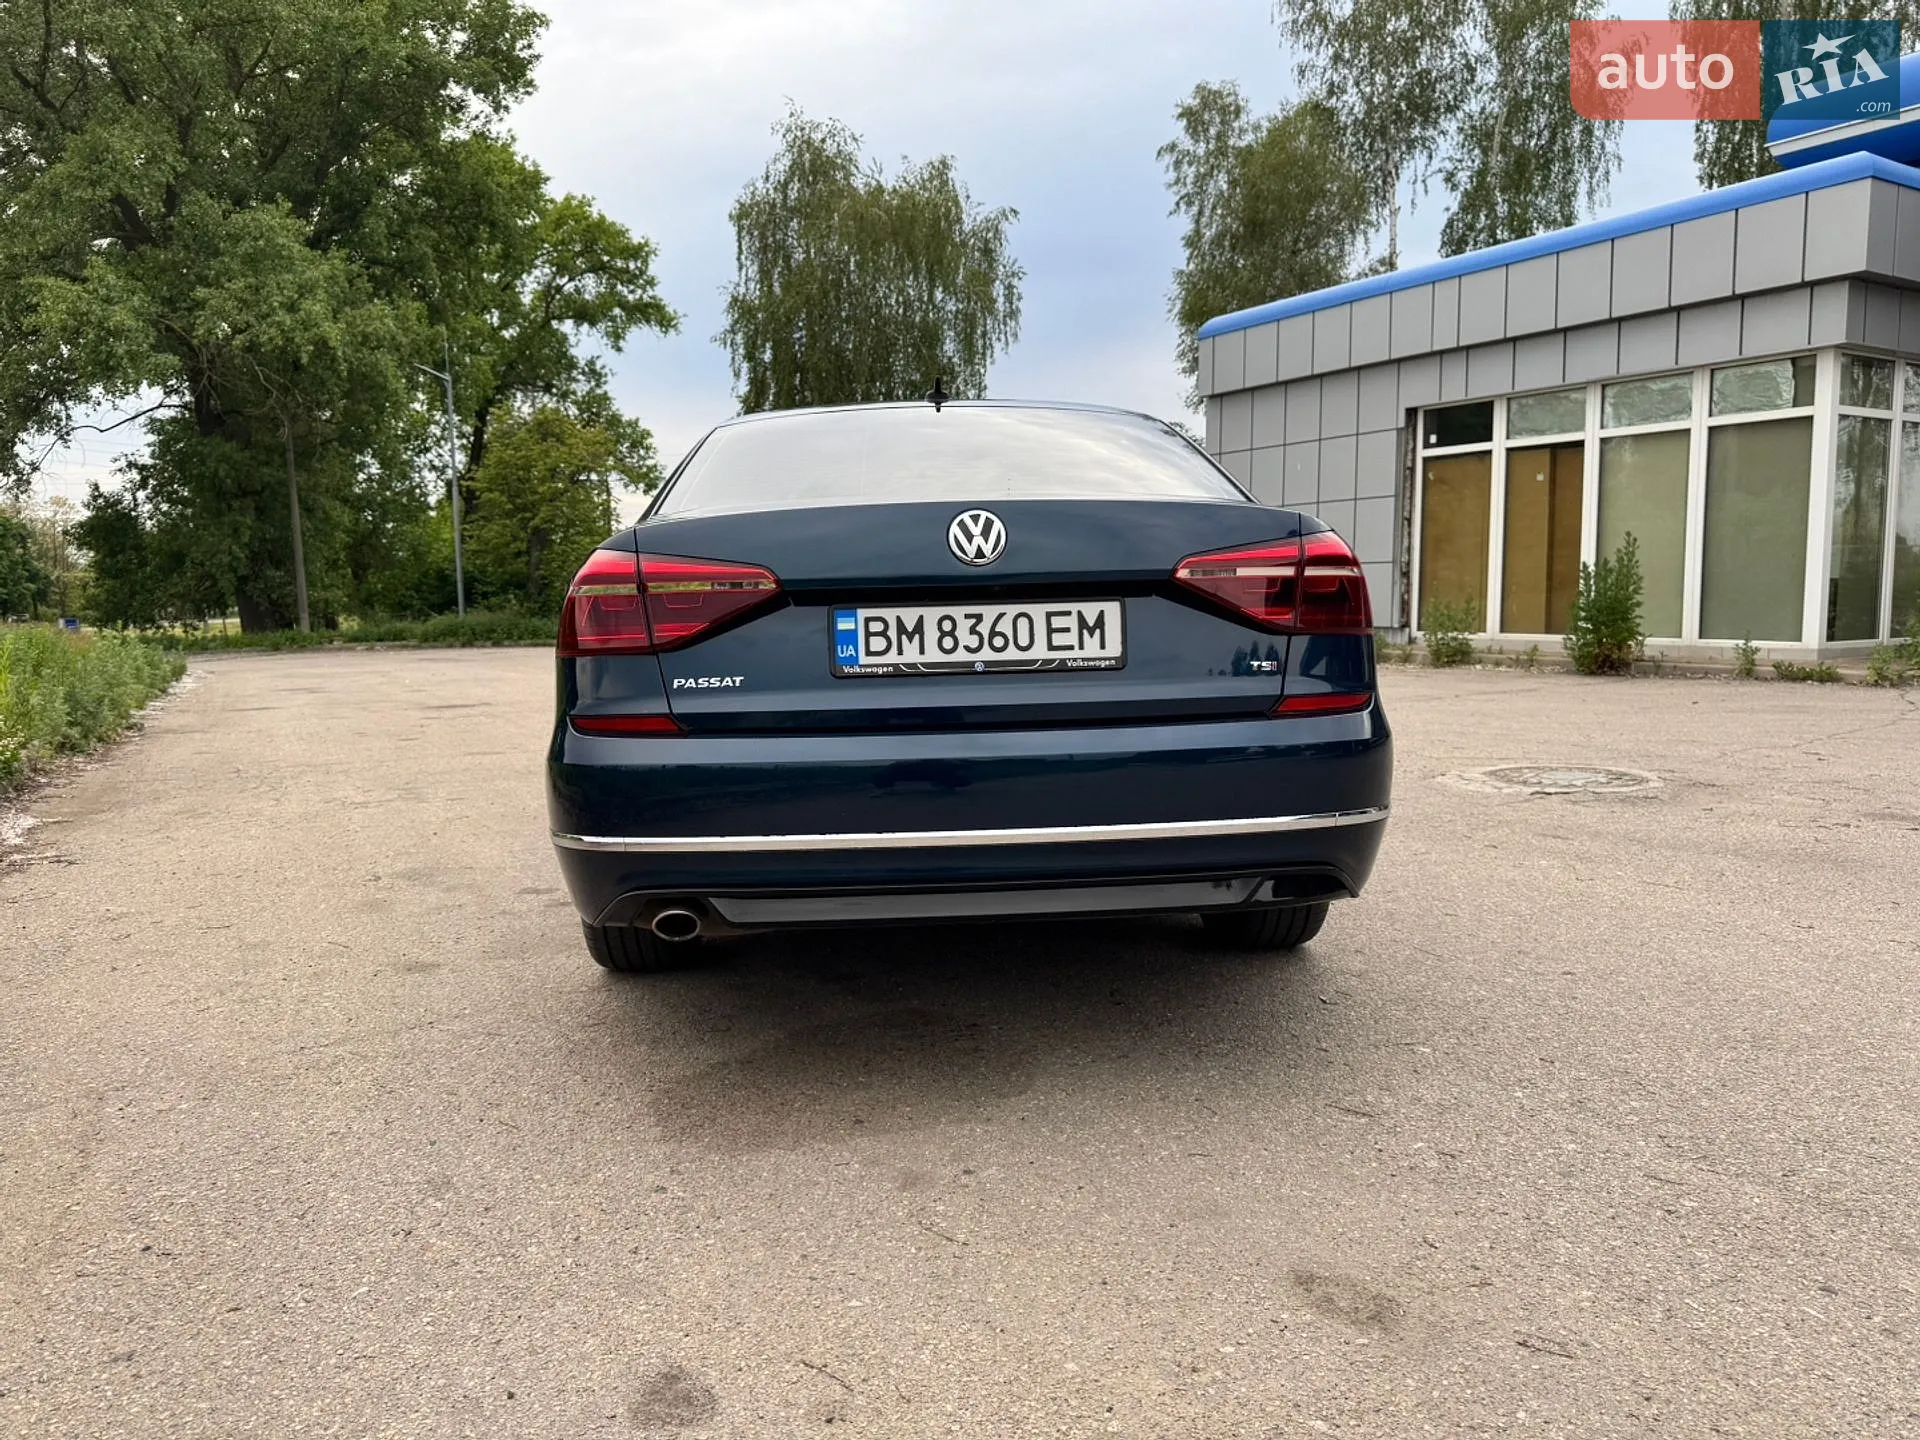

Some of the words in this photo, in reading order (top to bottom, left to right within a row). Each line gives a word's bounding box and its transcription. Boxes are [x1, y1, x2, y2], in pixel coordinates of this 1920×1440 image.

[863, 614, 925, 657] BM
[937, 611, 1035, 655] 8360
[1045, 609, 1106, 652] EM
[837, 645, 857, 658] UA
[1066, 658, 1116, 668] Volkswagen
[1250, 661, 1277, 671] TSI
[842, 665, 894, 674] Volkswagen
[673, 676, 744, 689] PASSAT
